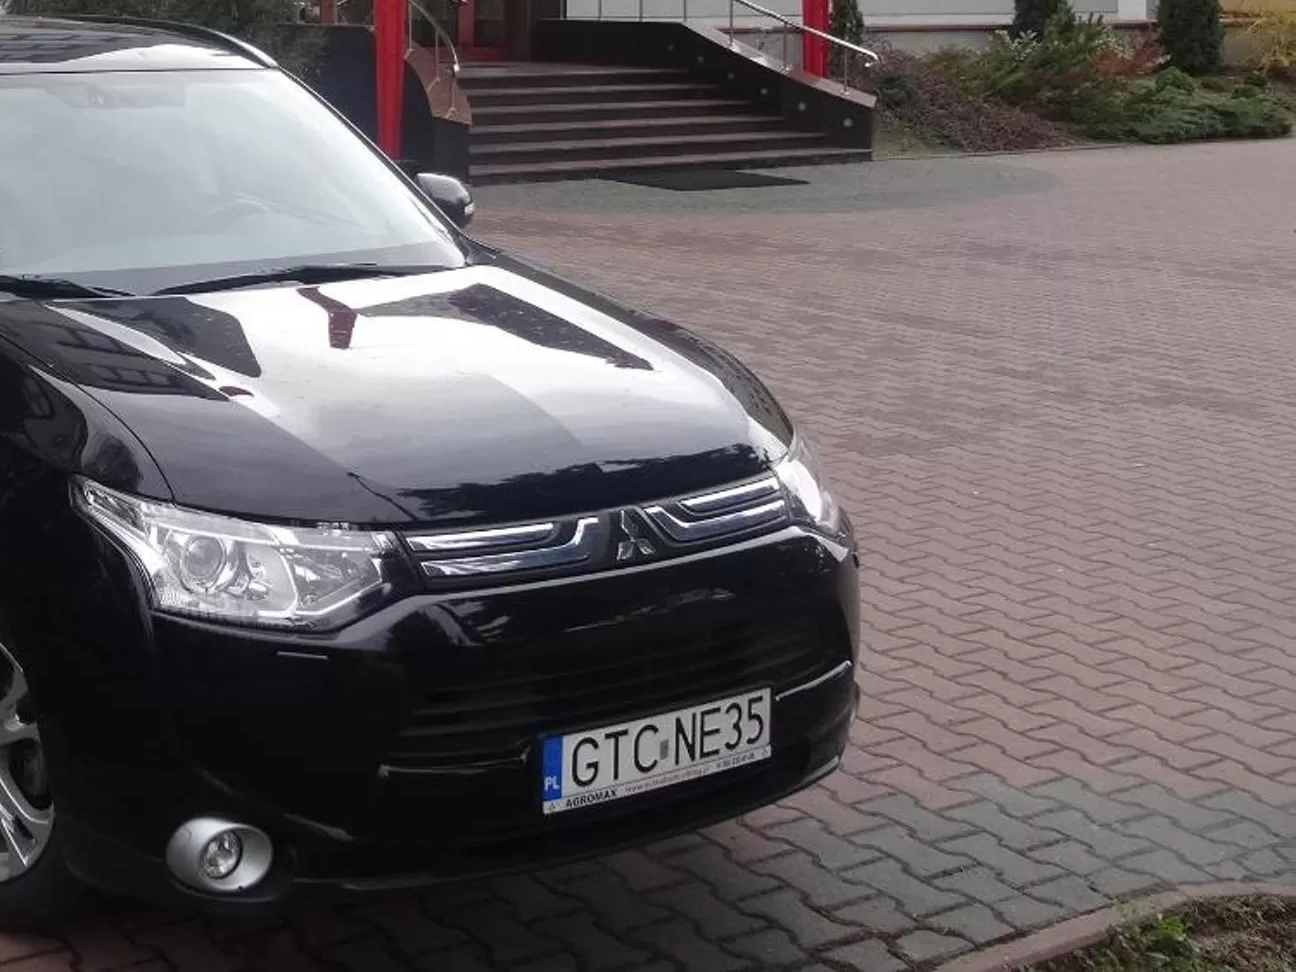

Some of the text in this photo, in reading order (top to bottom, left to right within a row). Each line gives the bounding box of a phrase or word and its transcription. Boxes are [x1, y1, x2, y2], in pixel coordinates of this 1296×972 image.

[571, 724, 659, 787] GTC
[674, 695, 764, 766] NE35
[544, 776, 560, 792] PL
[566, 788, 618, 808] AGROMAX
